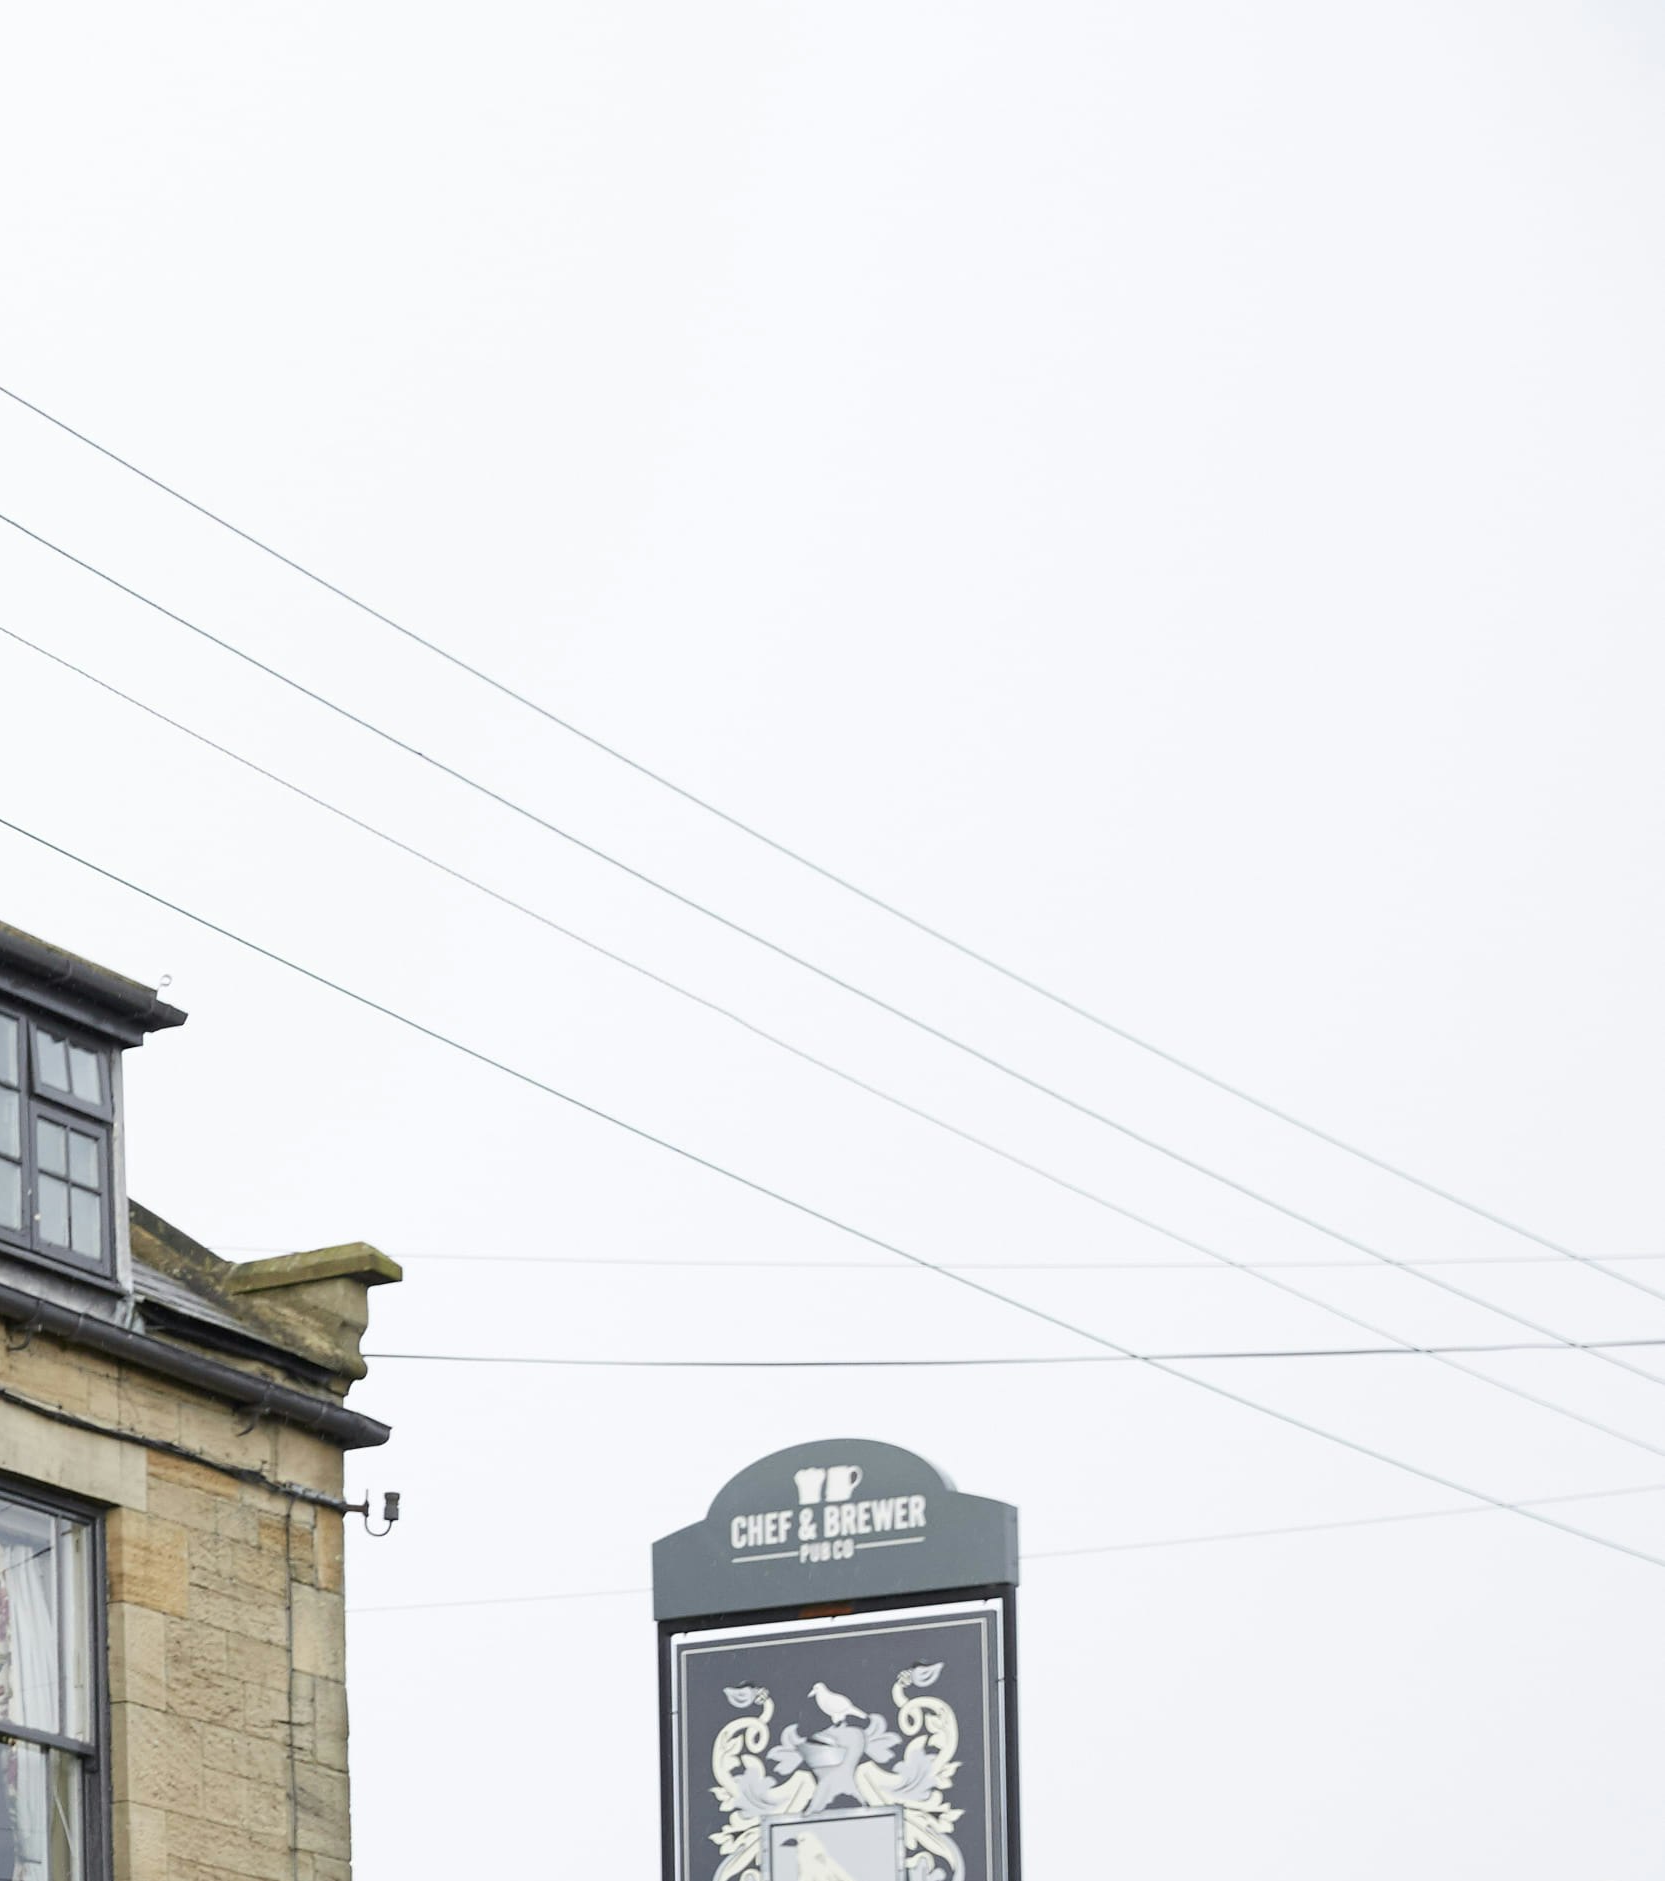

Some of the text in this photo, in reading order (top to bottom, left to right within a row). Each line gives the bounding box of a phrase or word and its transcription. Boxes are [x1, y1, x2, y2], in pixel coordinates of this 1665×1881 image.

[731, 1494, 927, 1549] CHEF & BREWER
[799, 1541, 832, 1563] PUB
